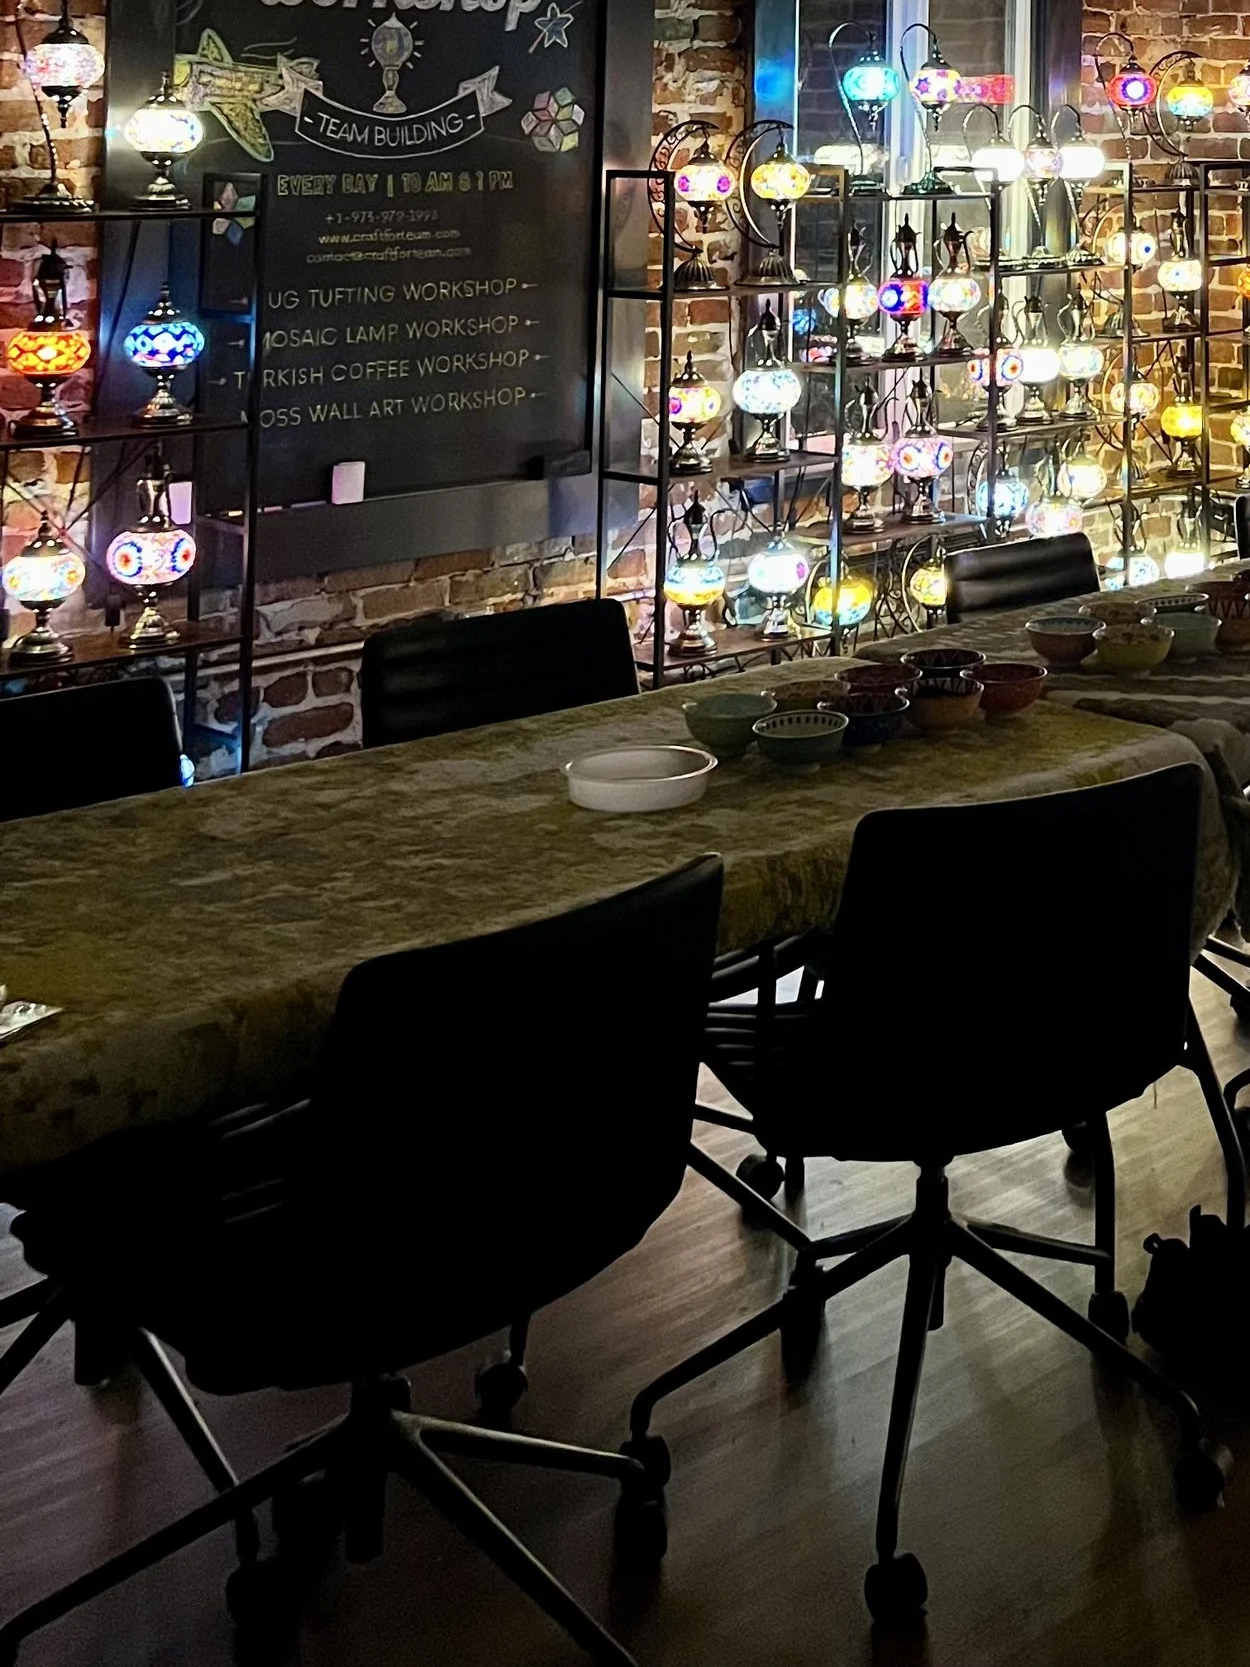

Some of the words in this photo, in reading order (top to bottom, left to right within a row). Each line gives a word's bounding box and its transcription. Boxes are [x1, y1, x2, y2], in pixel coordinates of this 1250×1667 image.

[318, 111, 370, 146] TEAM
[373, 112, 464, 147] BUILDING
[277, 174, 337, 196] EVERY
[342, 173, 379, 195] DAY
[401, 172, 422, 193] 10
[425, 170, 453, 192] AM
[475, 170, 484, 191] 1
[488, 170, 514, 191] PM
[268, 289, 300, 310] UG
[308, 285, 395, 309] TUFTING
[402, 277, 517, 301] WORKSHOP
[346, 323, 399, 345] LAMP
[405, 315, 519, 339] WORKSHOP
[233, 365, 324, 390] TRKISH
[331, 359, 410, 382] COFFEE
[416, 349, 530, 377] WORKSHOP
[308, 401, 362, 423] WALL
[369, 398, 405, 418] ART
[411, 386, 527, 414] WORKSHOP
